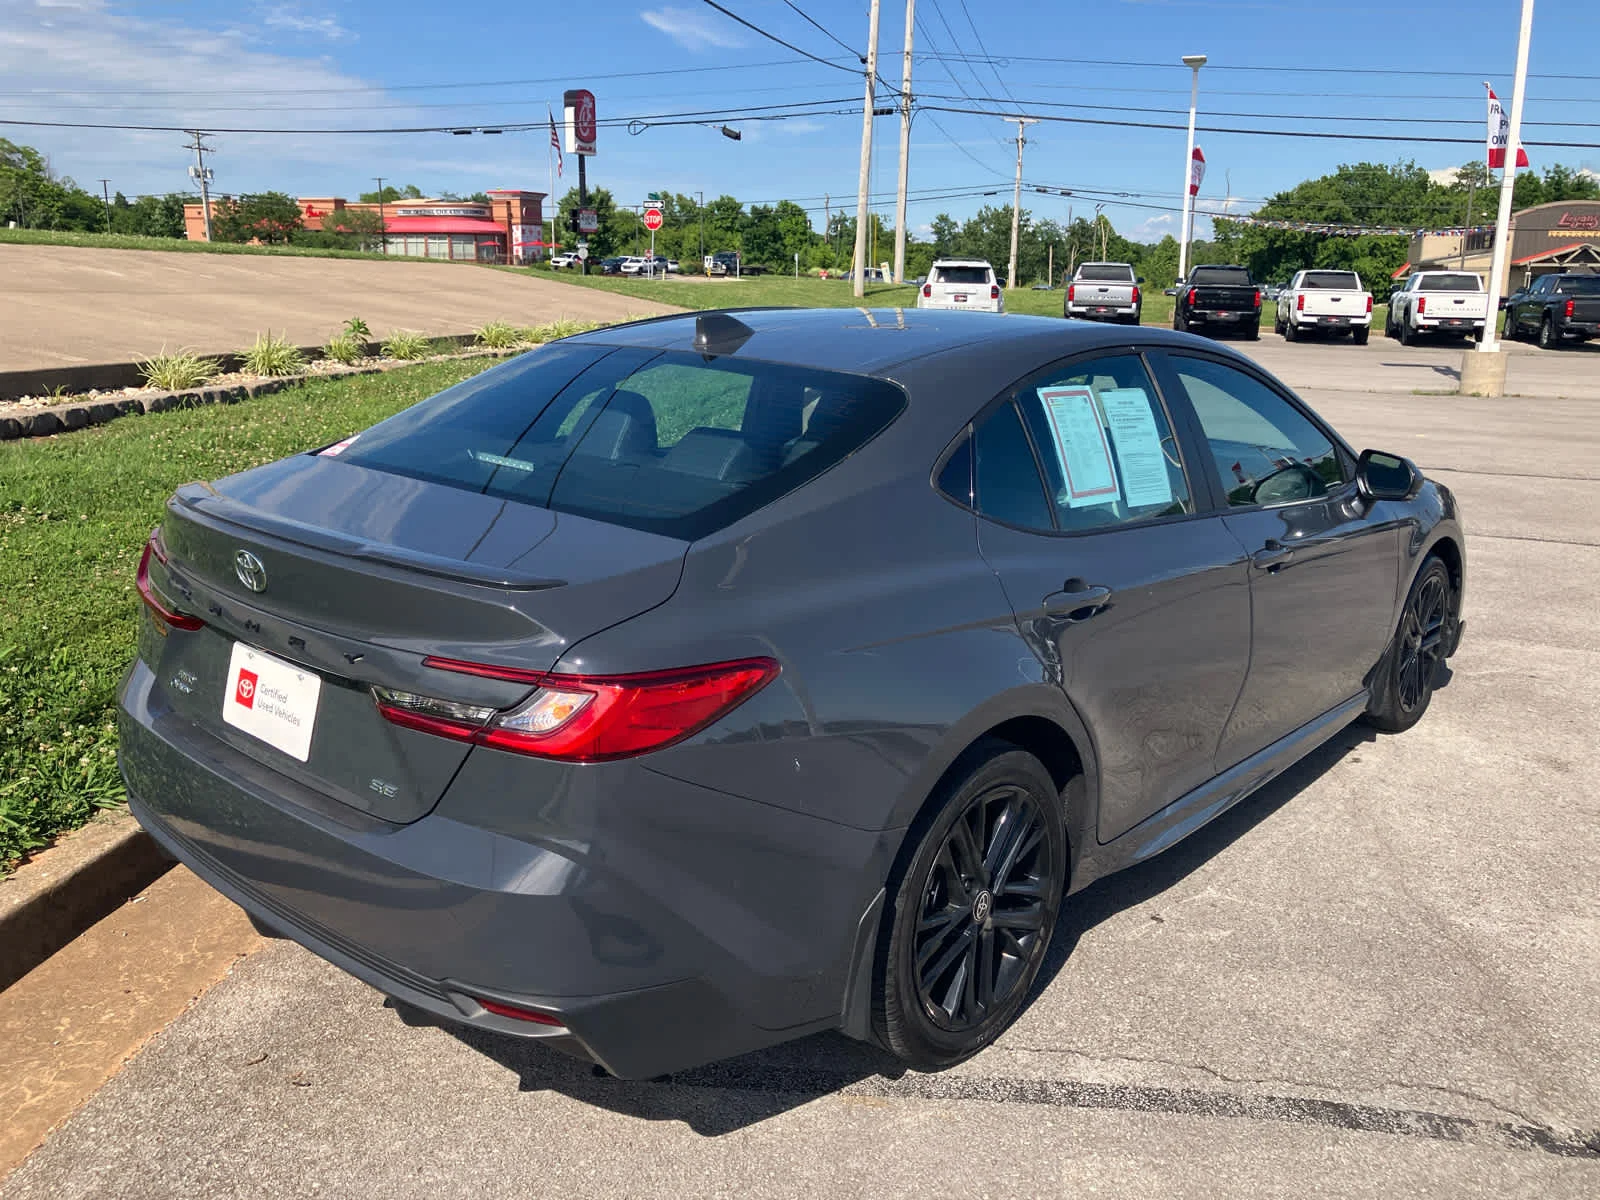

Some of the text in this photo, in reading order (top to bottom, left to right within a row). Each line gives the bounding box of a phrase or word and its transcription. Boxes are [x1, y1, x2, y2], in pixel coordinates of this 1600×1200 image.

[644, 215, 661, 225] STOP
[260, 683, 288, 704] Certified
[256, 697, 301, 727] Used Vehicles
[369, 779, 398, 798] SE
